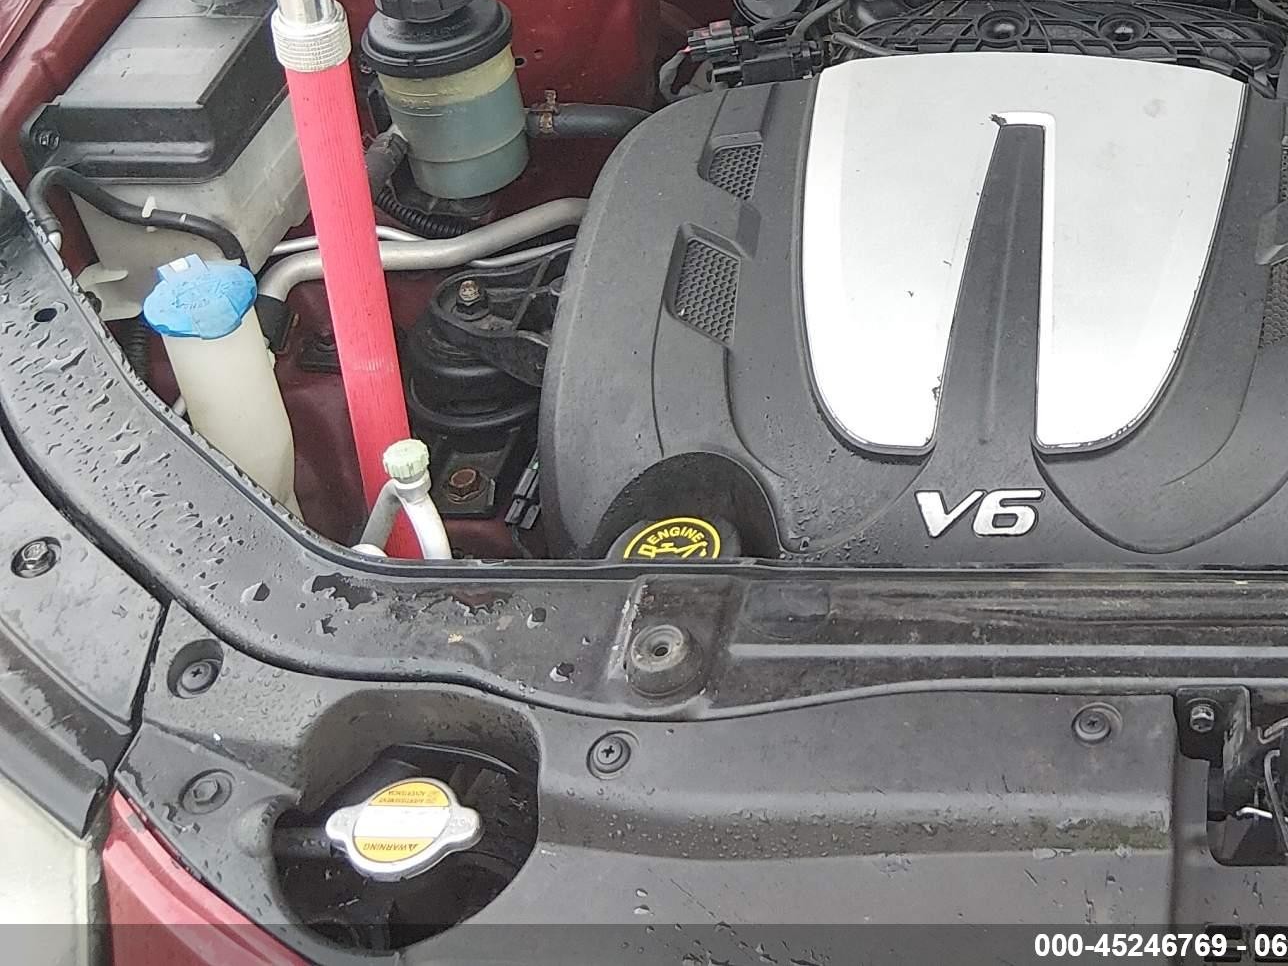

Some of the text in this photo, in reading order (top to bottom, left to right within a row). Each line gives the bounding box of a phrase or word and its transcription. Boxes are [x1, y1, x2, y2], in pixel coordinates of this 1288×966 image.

[914, 488, 1046, 538] V6
[646, 526, 705, 545] ENGINE
[362, 842, 407, 851] WARNING
